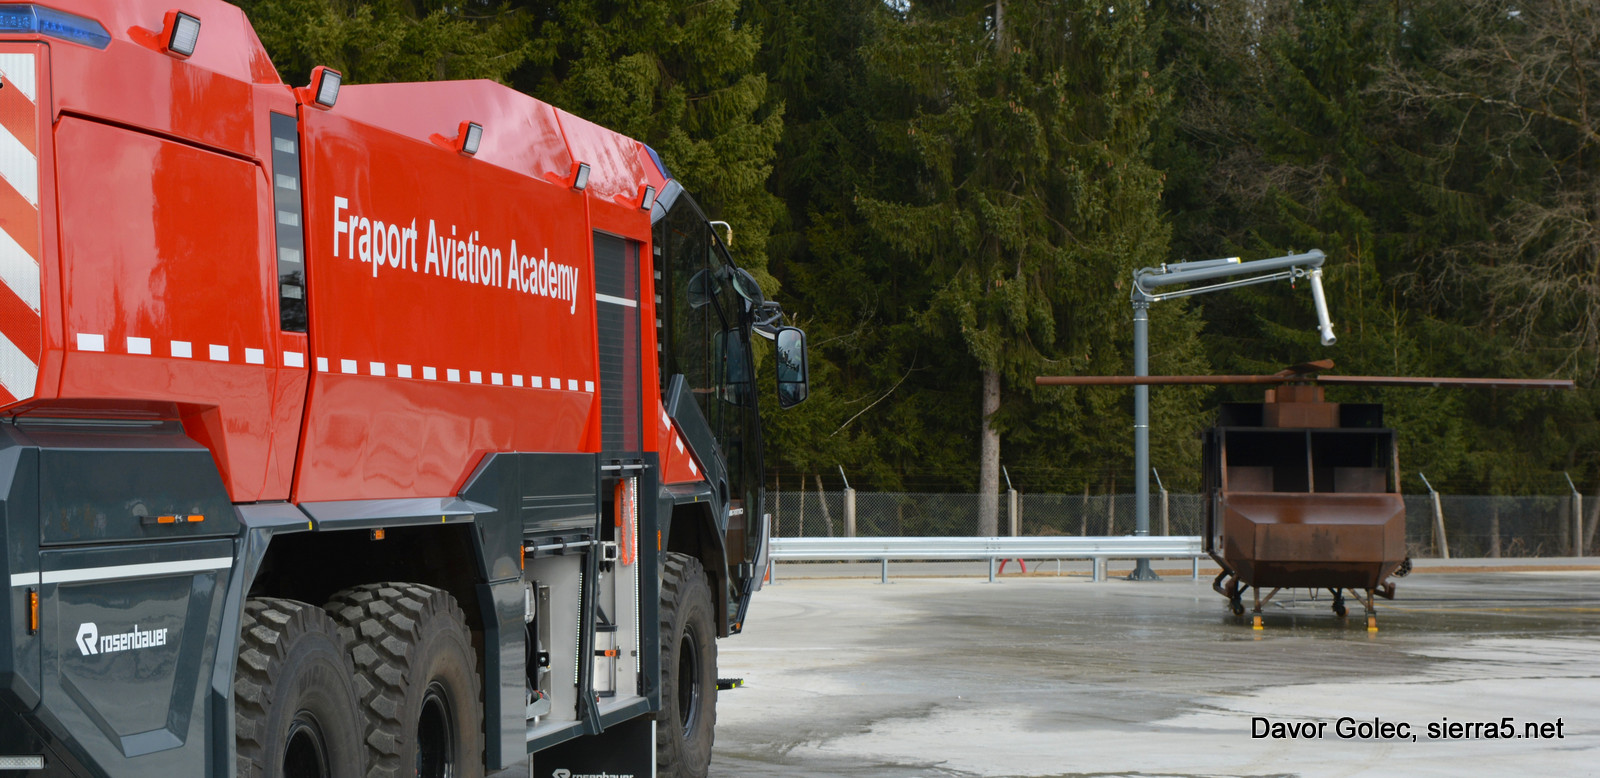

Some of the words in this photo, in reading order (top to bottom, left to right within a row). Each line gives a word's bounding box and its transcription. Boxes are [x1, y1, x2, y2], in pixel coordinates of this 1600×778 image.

[333, 195, 418, 278] Fraport
[424, 219, 502, 287] Aviation
[507, 239, 579, 315] Academy
[100, 624, 168, 654] rosenbauer
